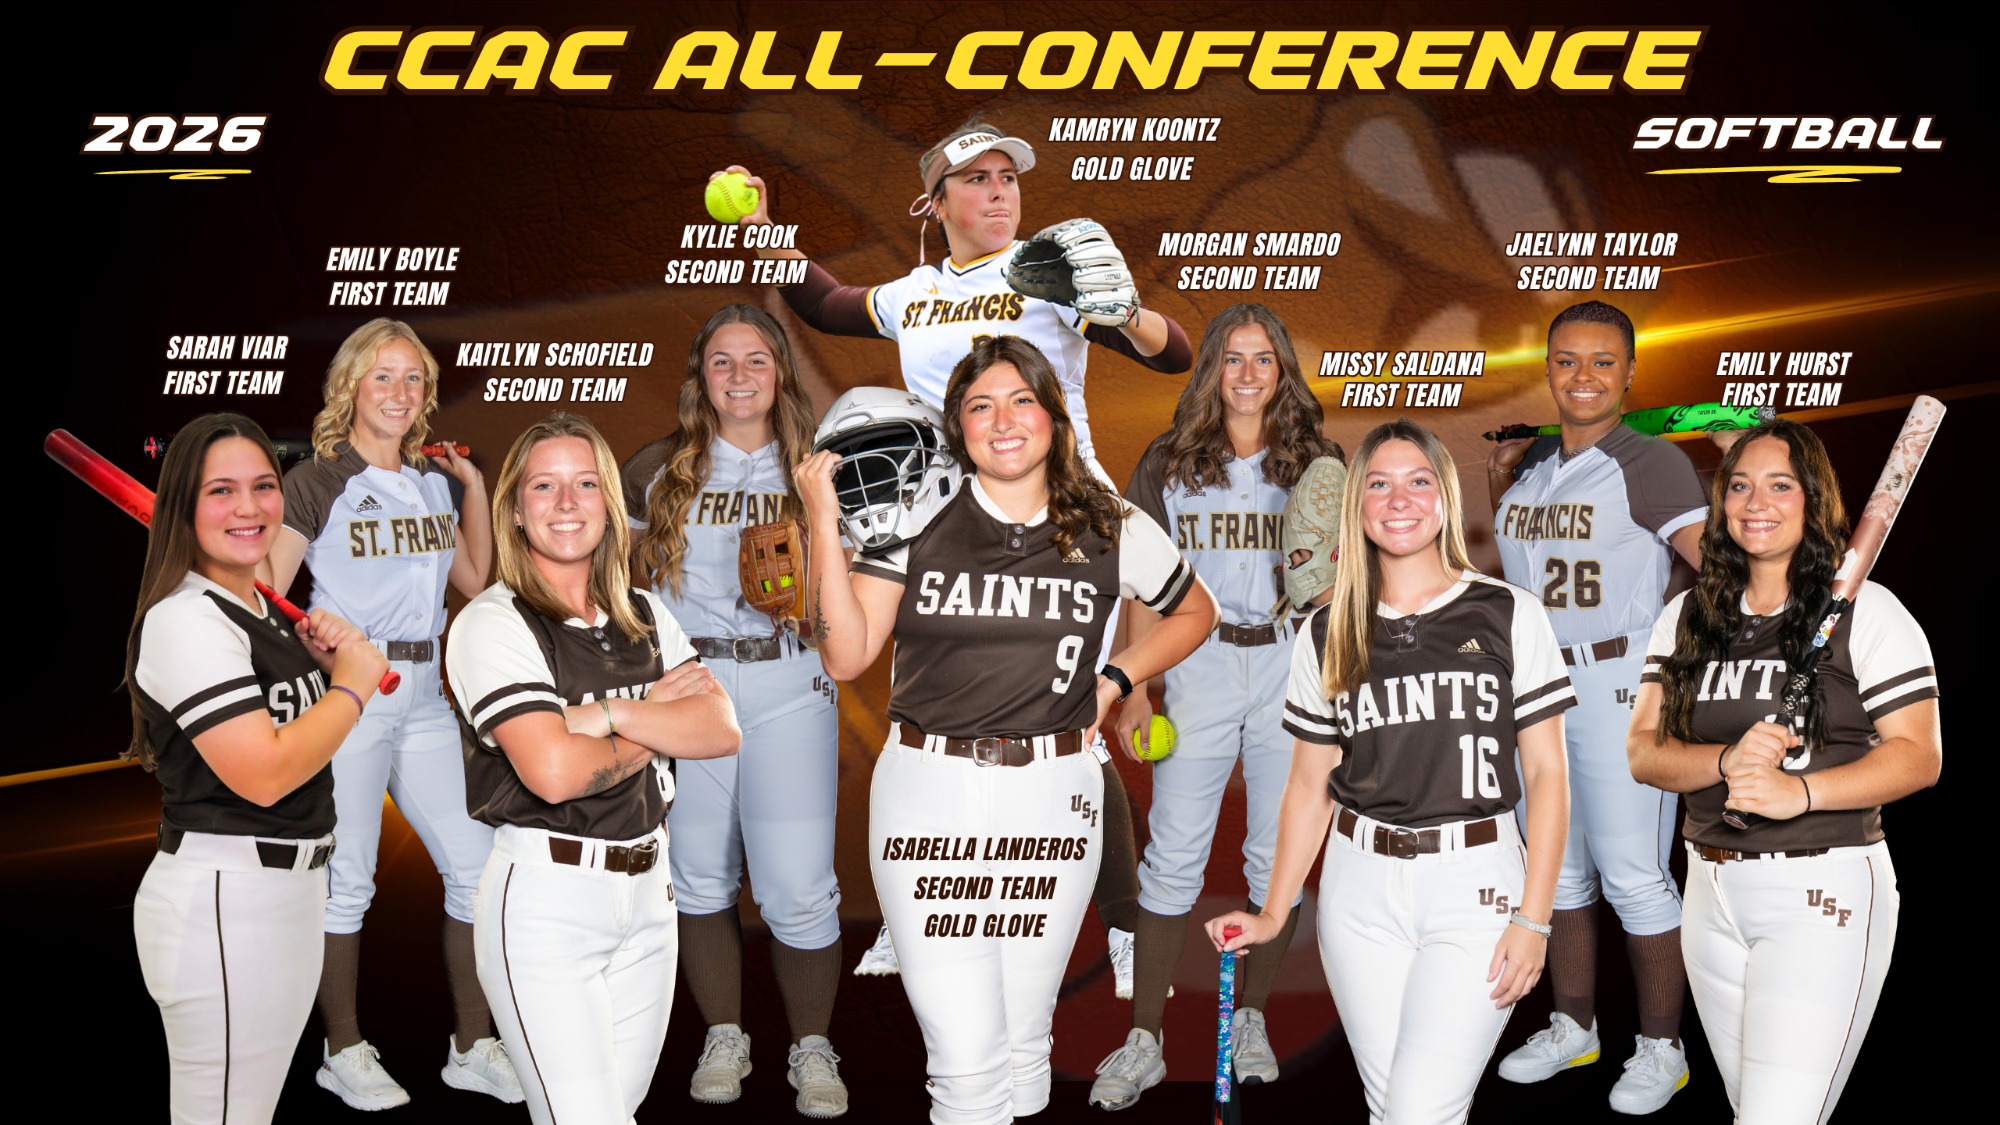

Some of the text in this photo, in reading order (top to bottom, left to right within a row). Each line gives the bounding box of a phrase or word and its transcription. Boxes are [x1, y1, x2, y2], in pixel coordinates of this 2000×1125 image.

[926, 292, 1026, 327] FRANCIS
[356, 503, 382, 513] adidas
[1183, 489, 1206, 498] adidas
[348, 518, 388, 559] ST.
[1176, 511, 1284, 552] ST. FRAN
[916, 570, 1098, 624] SAINTS
[1542, 555, 1602, 611] 26
[1051, 634, 1085, 695] 9
[1336, 671, 1499, 738] SAINTS
[1459, 734, 1502, 799] 16
[1070, 793, 1098, 828] USF
[1806, 888, 1852, 927] USF
